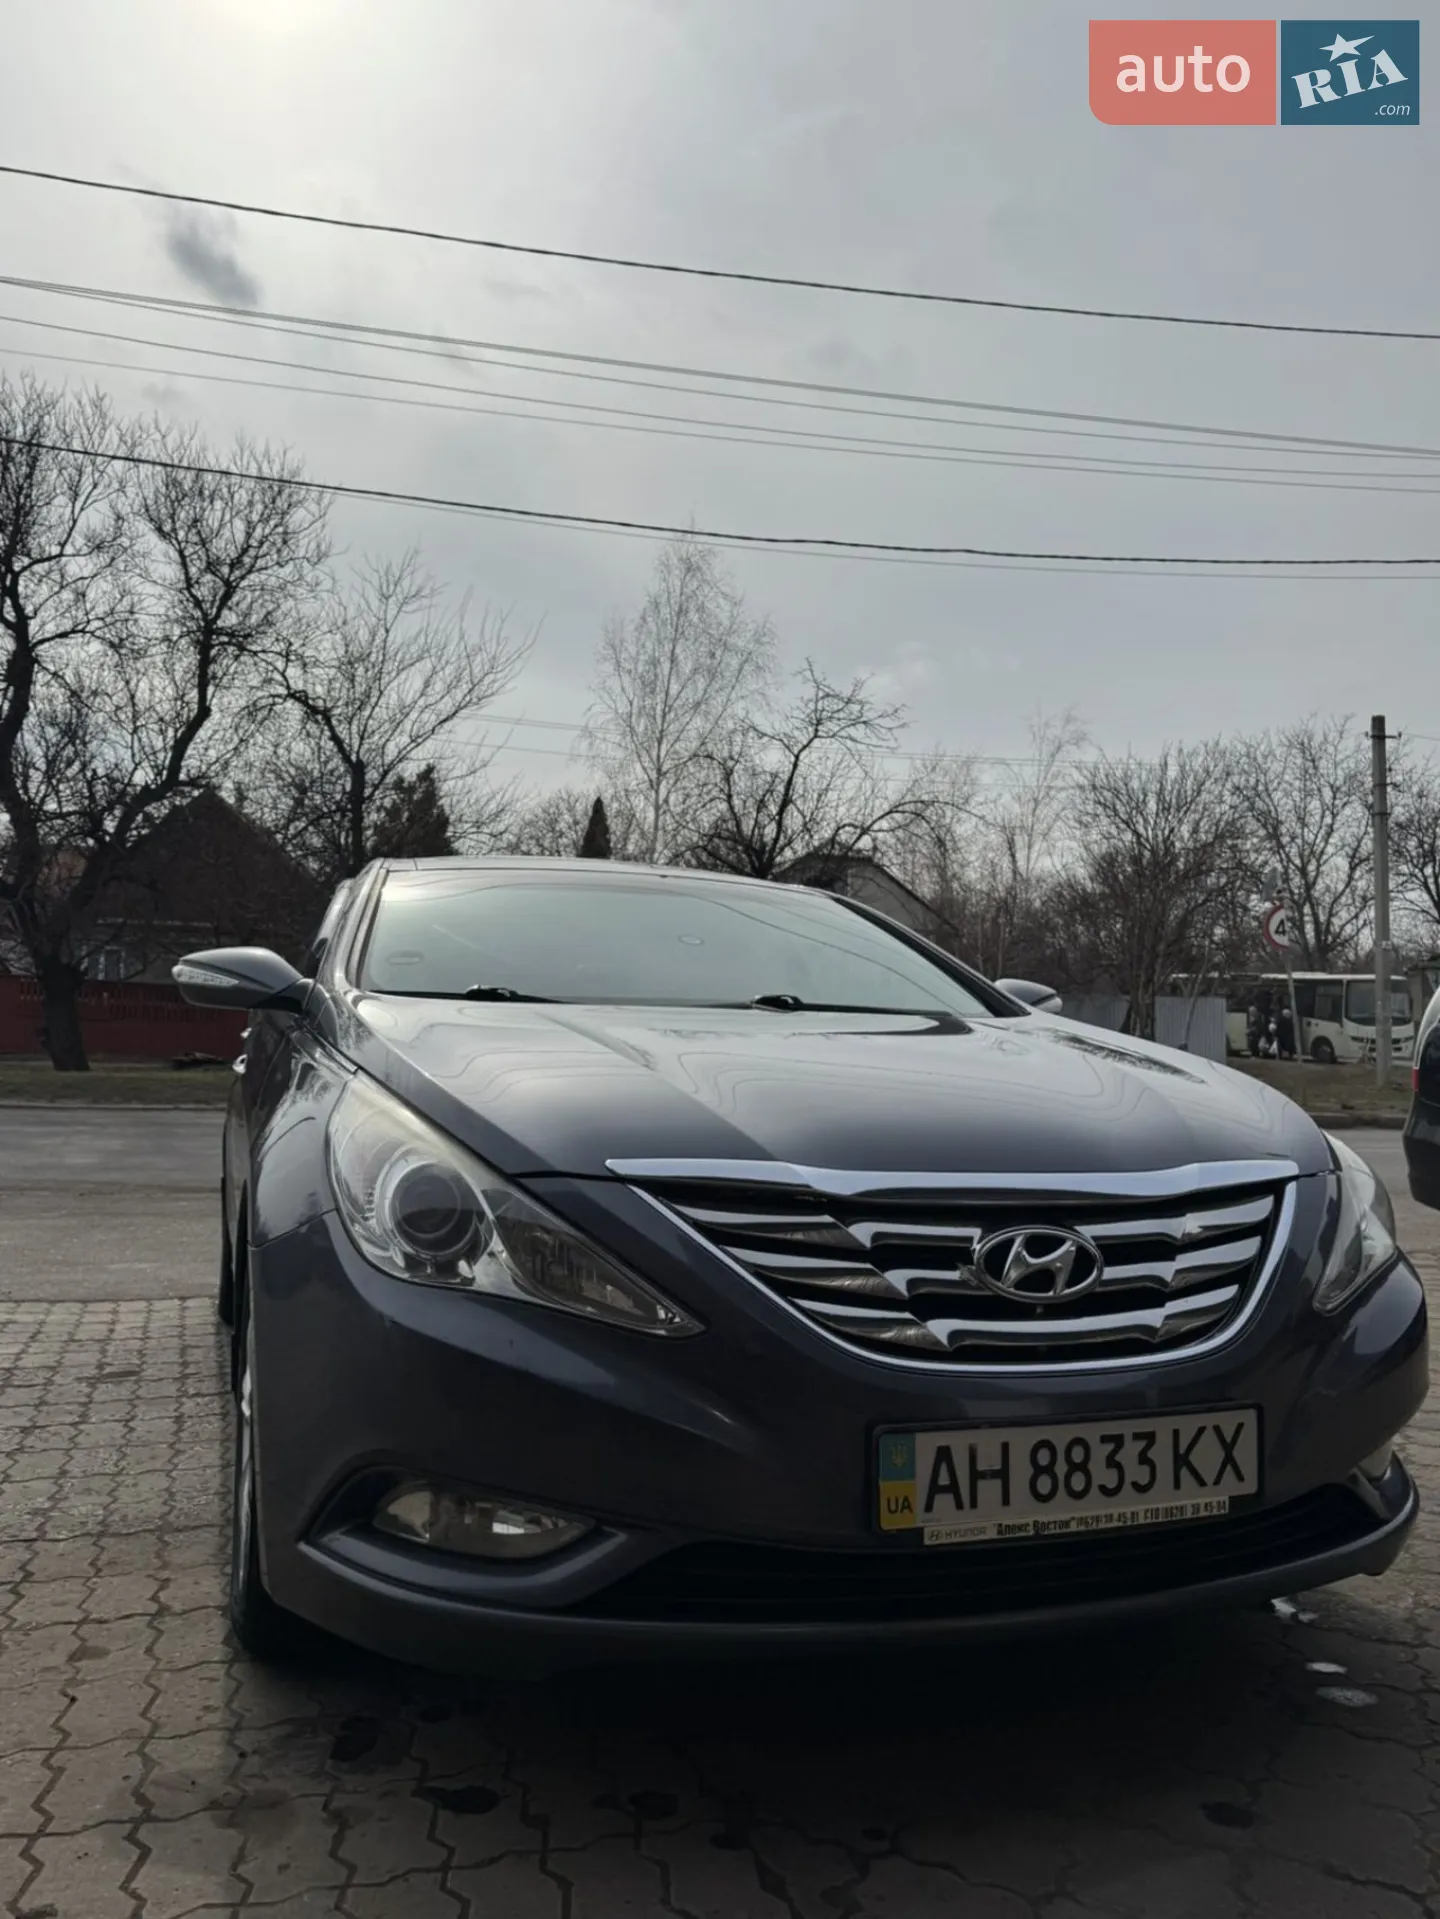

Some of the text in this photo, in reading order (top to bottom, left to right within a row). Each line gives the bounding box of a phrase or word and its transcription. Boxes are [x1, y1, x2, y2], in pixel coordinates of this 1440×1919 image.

[923, 1421, 1246, 1514] AH 8833 KX
[886, 1495, 913, 1514] UA
